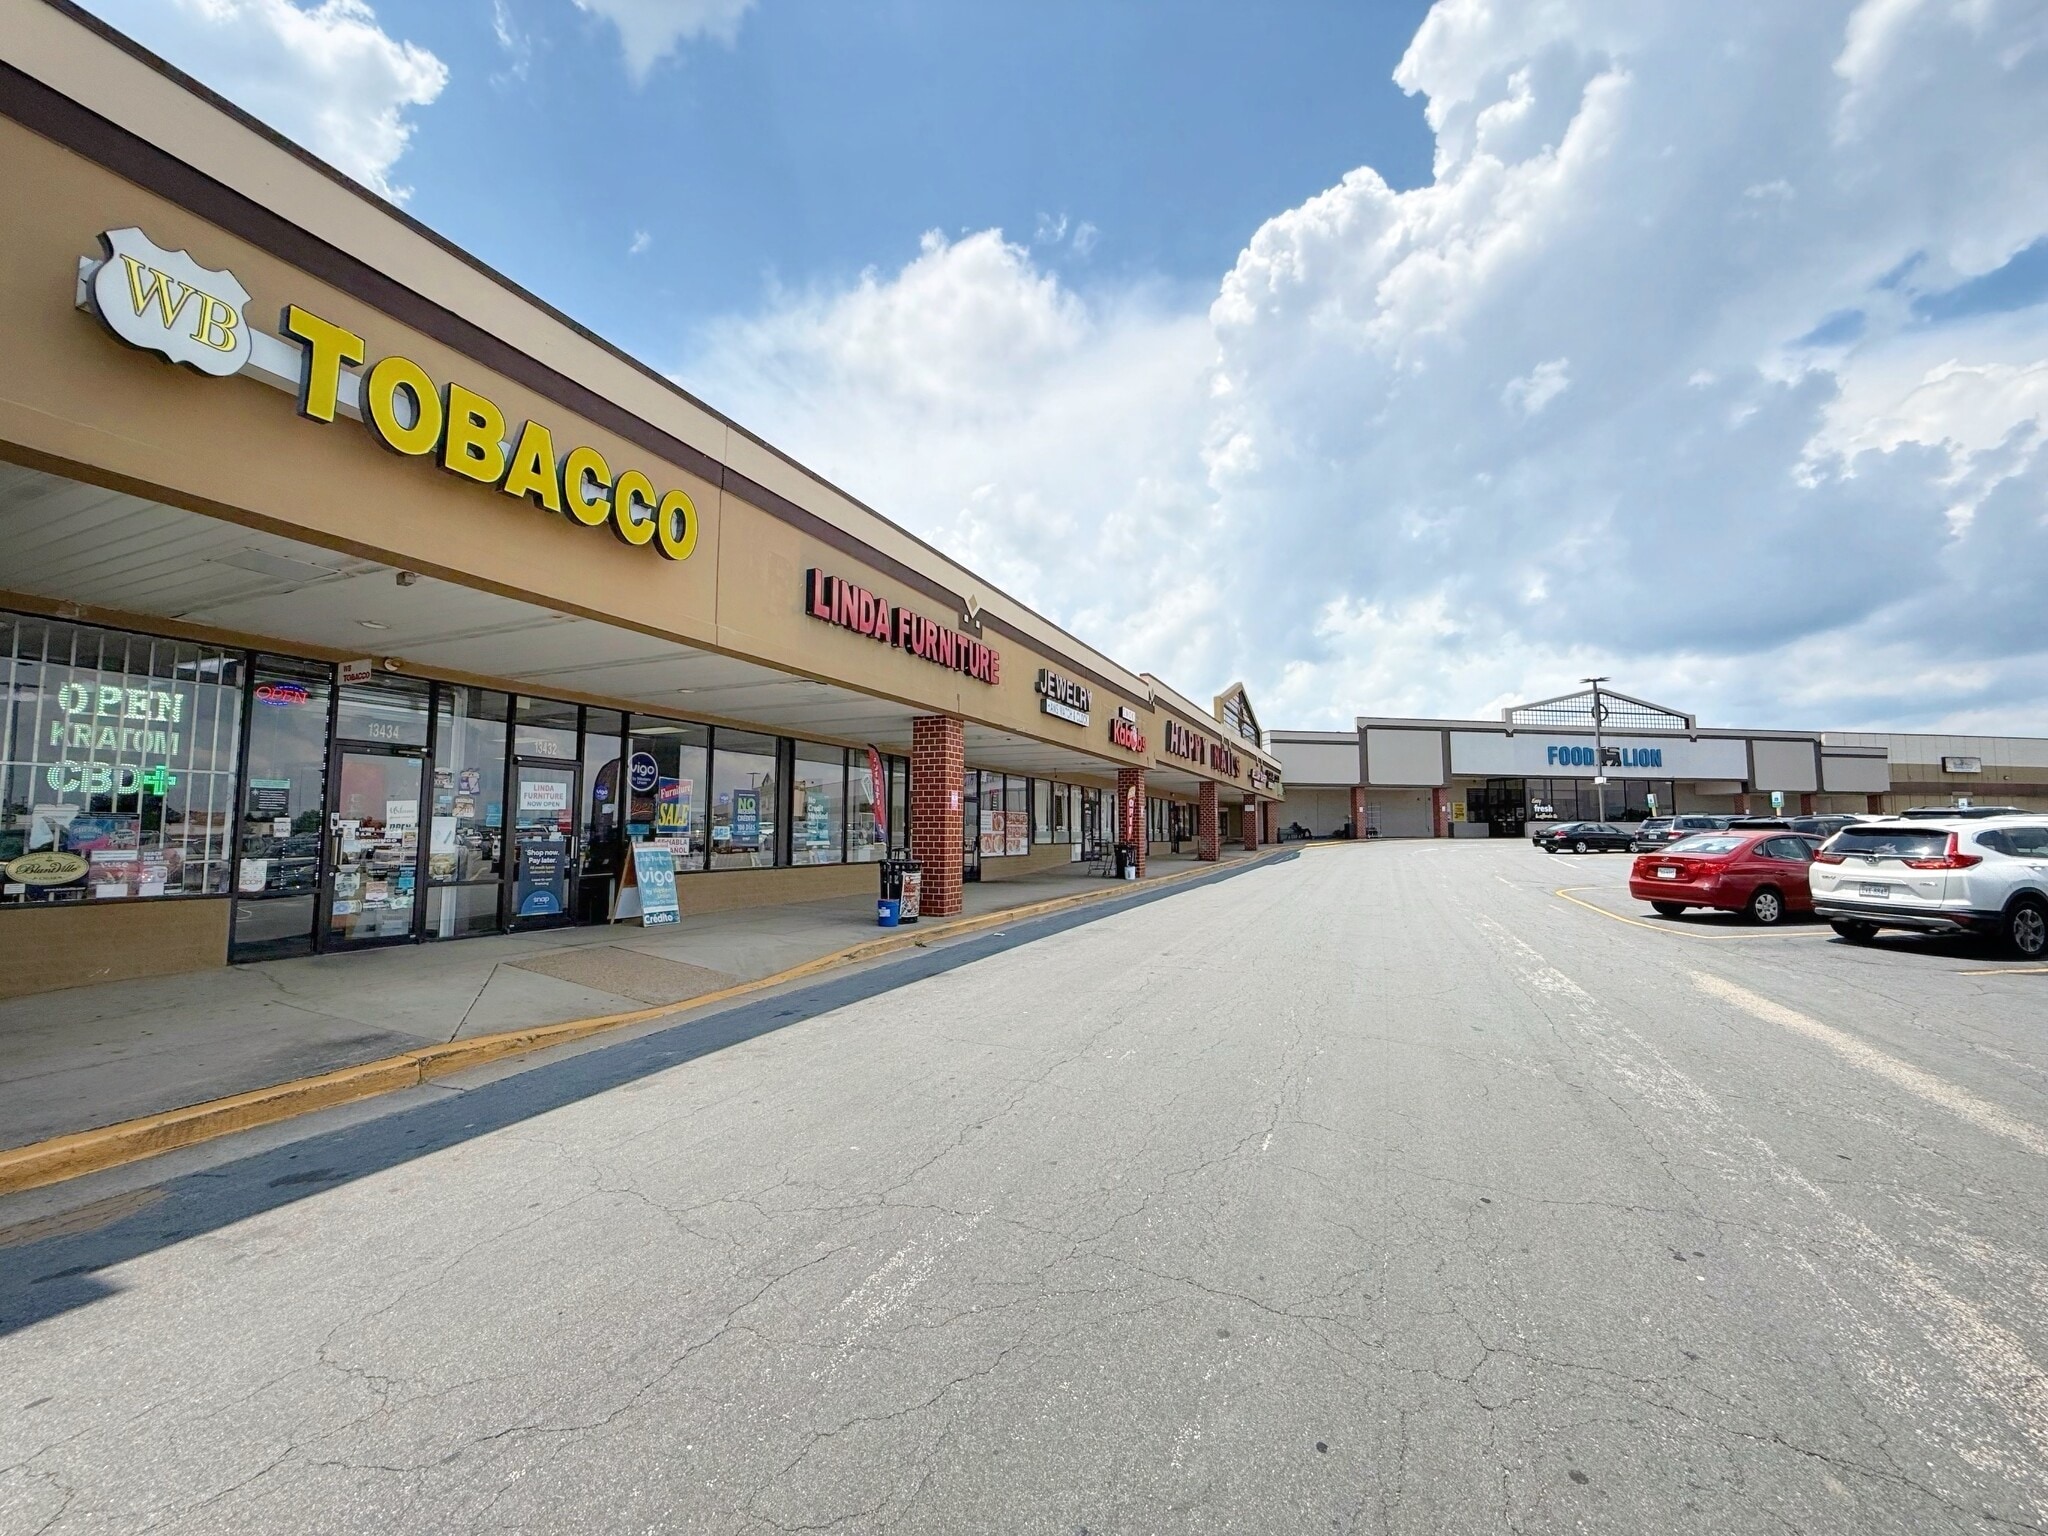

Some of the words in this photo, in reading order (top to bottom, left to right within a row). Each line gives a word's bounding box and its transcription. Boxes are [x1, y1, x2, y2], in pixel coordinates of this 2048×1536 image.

[120, 254, 239, 352] WB
[281, 303, 699, 561] TOBACCO
[806, 567, 891, 642] LINDA
[892, 606, 1000, 685] FURNITURE
[343, 672, 370, 682] TOBACCO
[256, 686, 308, 704] OPEN
[1039, 668, 1092, 711] JEWELRY
[59, 683, 183, 722] OPEN
[50, 720, 180, 756] KRATOM
[369, 723, 400, 739] 13434
[534, 740, 558, 755] 13432
[1166, 720, 1206, 764] HAPPY
[1547, 746, 1595, 766] FOOD
[1622, 748, 1662, 767] LION
[631, 762, 655, 776] vigo
[524, 792, 564, 800] FURNITURE
[660, 784, 691, 799] Furniture
[737, 798, 756, 810] NO
[808, 804, 824, 812] Credit
[1534, 804, 1553, 813] fresh
[659, 802, 689, 826] SALE
[527, 849, 544, 857] Shop
[528, 857, 540, 865] Pay
[639, 867, 674, 886] vigo
[533, 896, 549, 904] snap
[644, 914, 673, 924] Crédito
